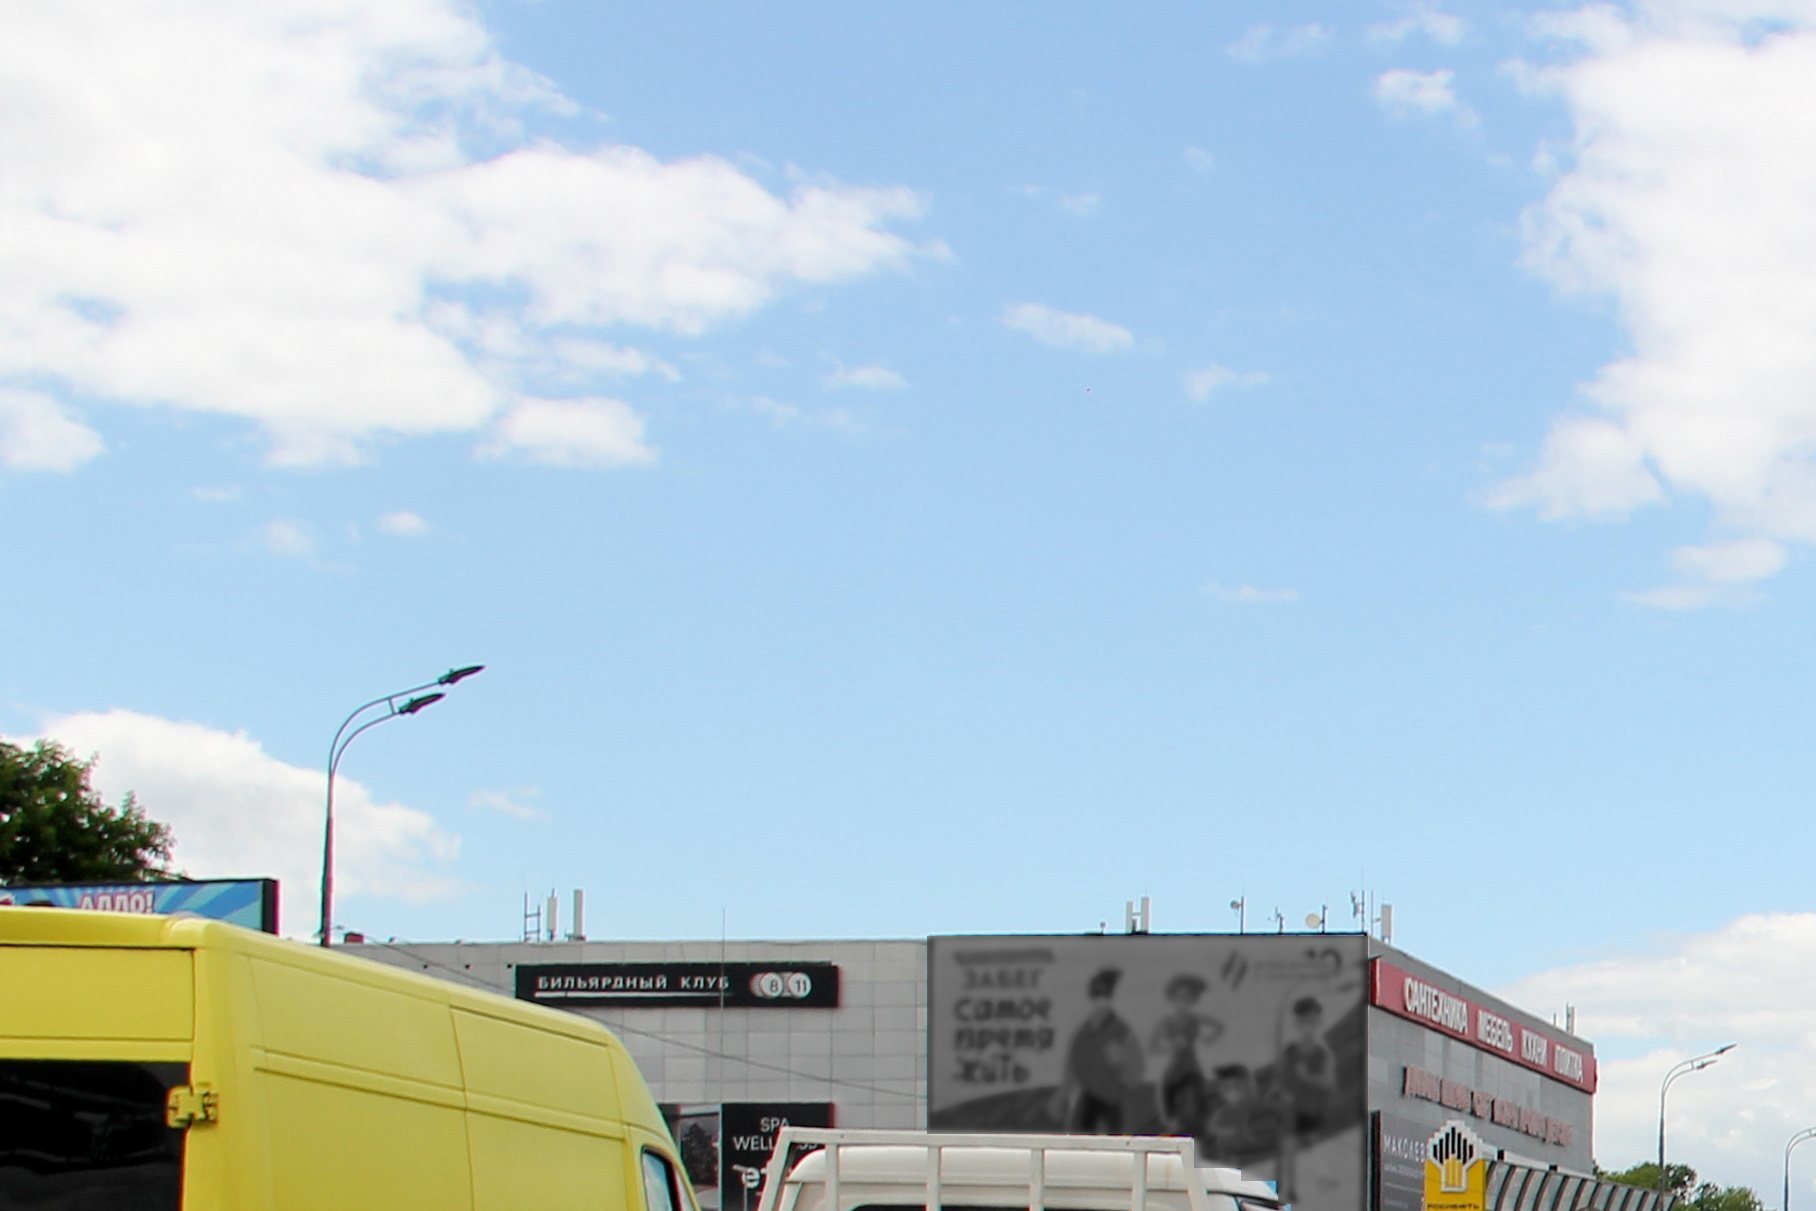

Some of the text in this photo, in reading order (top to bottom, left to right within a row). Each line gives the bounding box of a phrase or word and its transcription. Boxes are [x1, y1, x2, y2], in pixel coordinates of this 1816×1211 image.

[538, 975, 730, 989] БИЛЬЯРДНЫЙ КЛУБ
[1403, 976, 1469, 1035] САНТЕХНИКА
[1476, 1008, 1513, 1054] МЕБЕЛЬ
